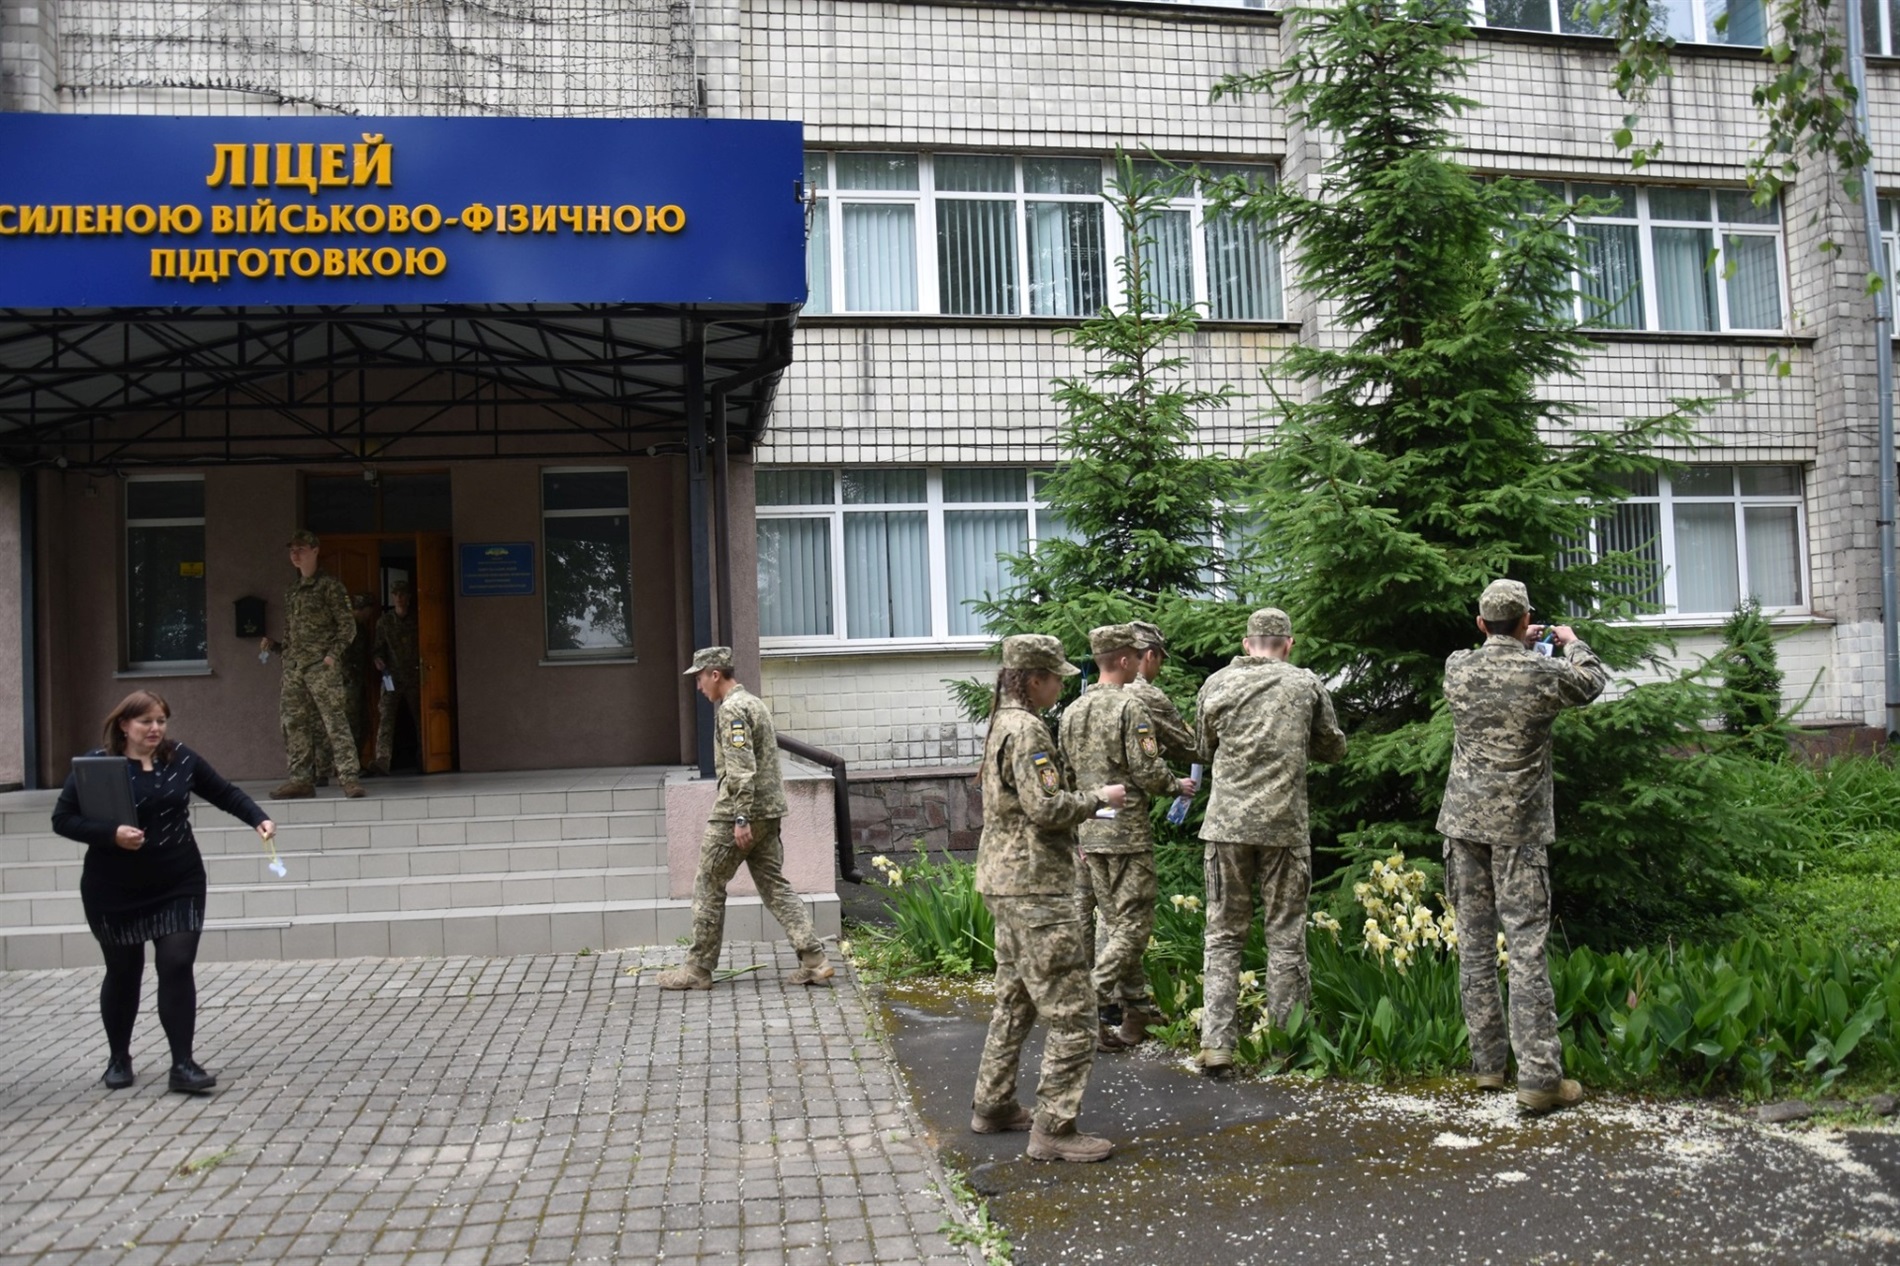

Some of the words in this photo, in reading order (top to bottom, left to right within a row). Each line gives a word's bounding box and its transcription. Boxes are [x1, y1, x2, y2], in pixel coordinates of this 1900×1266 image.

[206, 133, 392, 194] ЛІЦЕЙ
[212, 198, 686, 235] ВІЙСЬКОВО-ФІЗИЧНОЮ
[151, 247, 447, 283] ПІДГОТОВКОЮ
